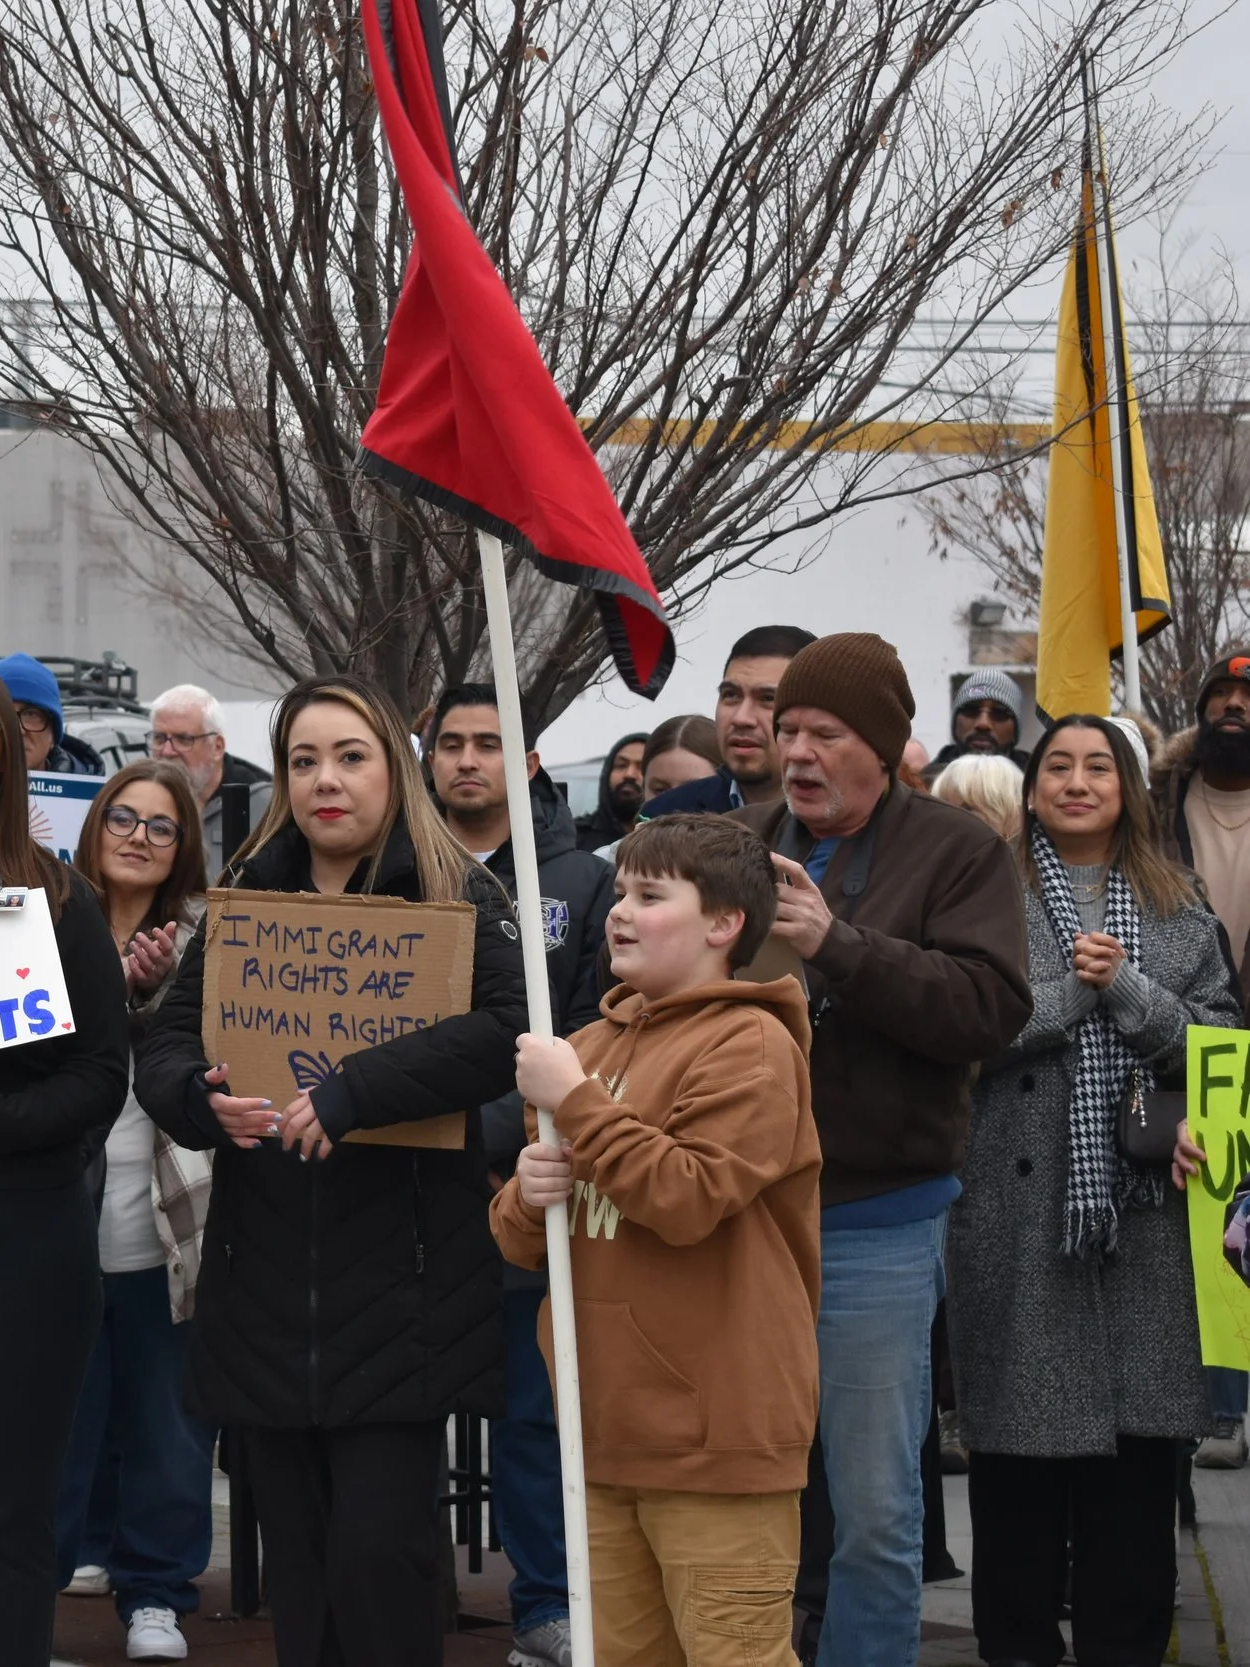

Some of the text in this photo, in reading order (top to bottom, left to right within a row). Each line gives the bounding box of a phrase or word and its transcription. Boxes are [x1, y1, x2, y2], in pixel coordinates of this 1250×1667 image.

[221, 915, 425, 959] IMMIGRANT
[242, 957, 414, 1000] RIGHTS ARE
[221, 1000, 310, 1037] HUMAN
